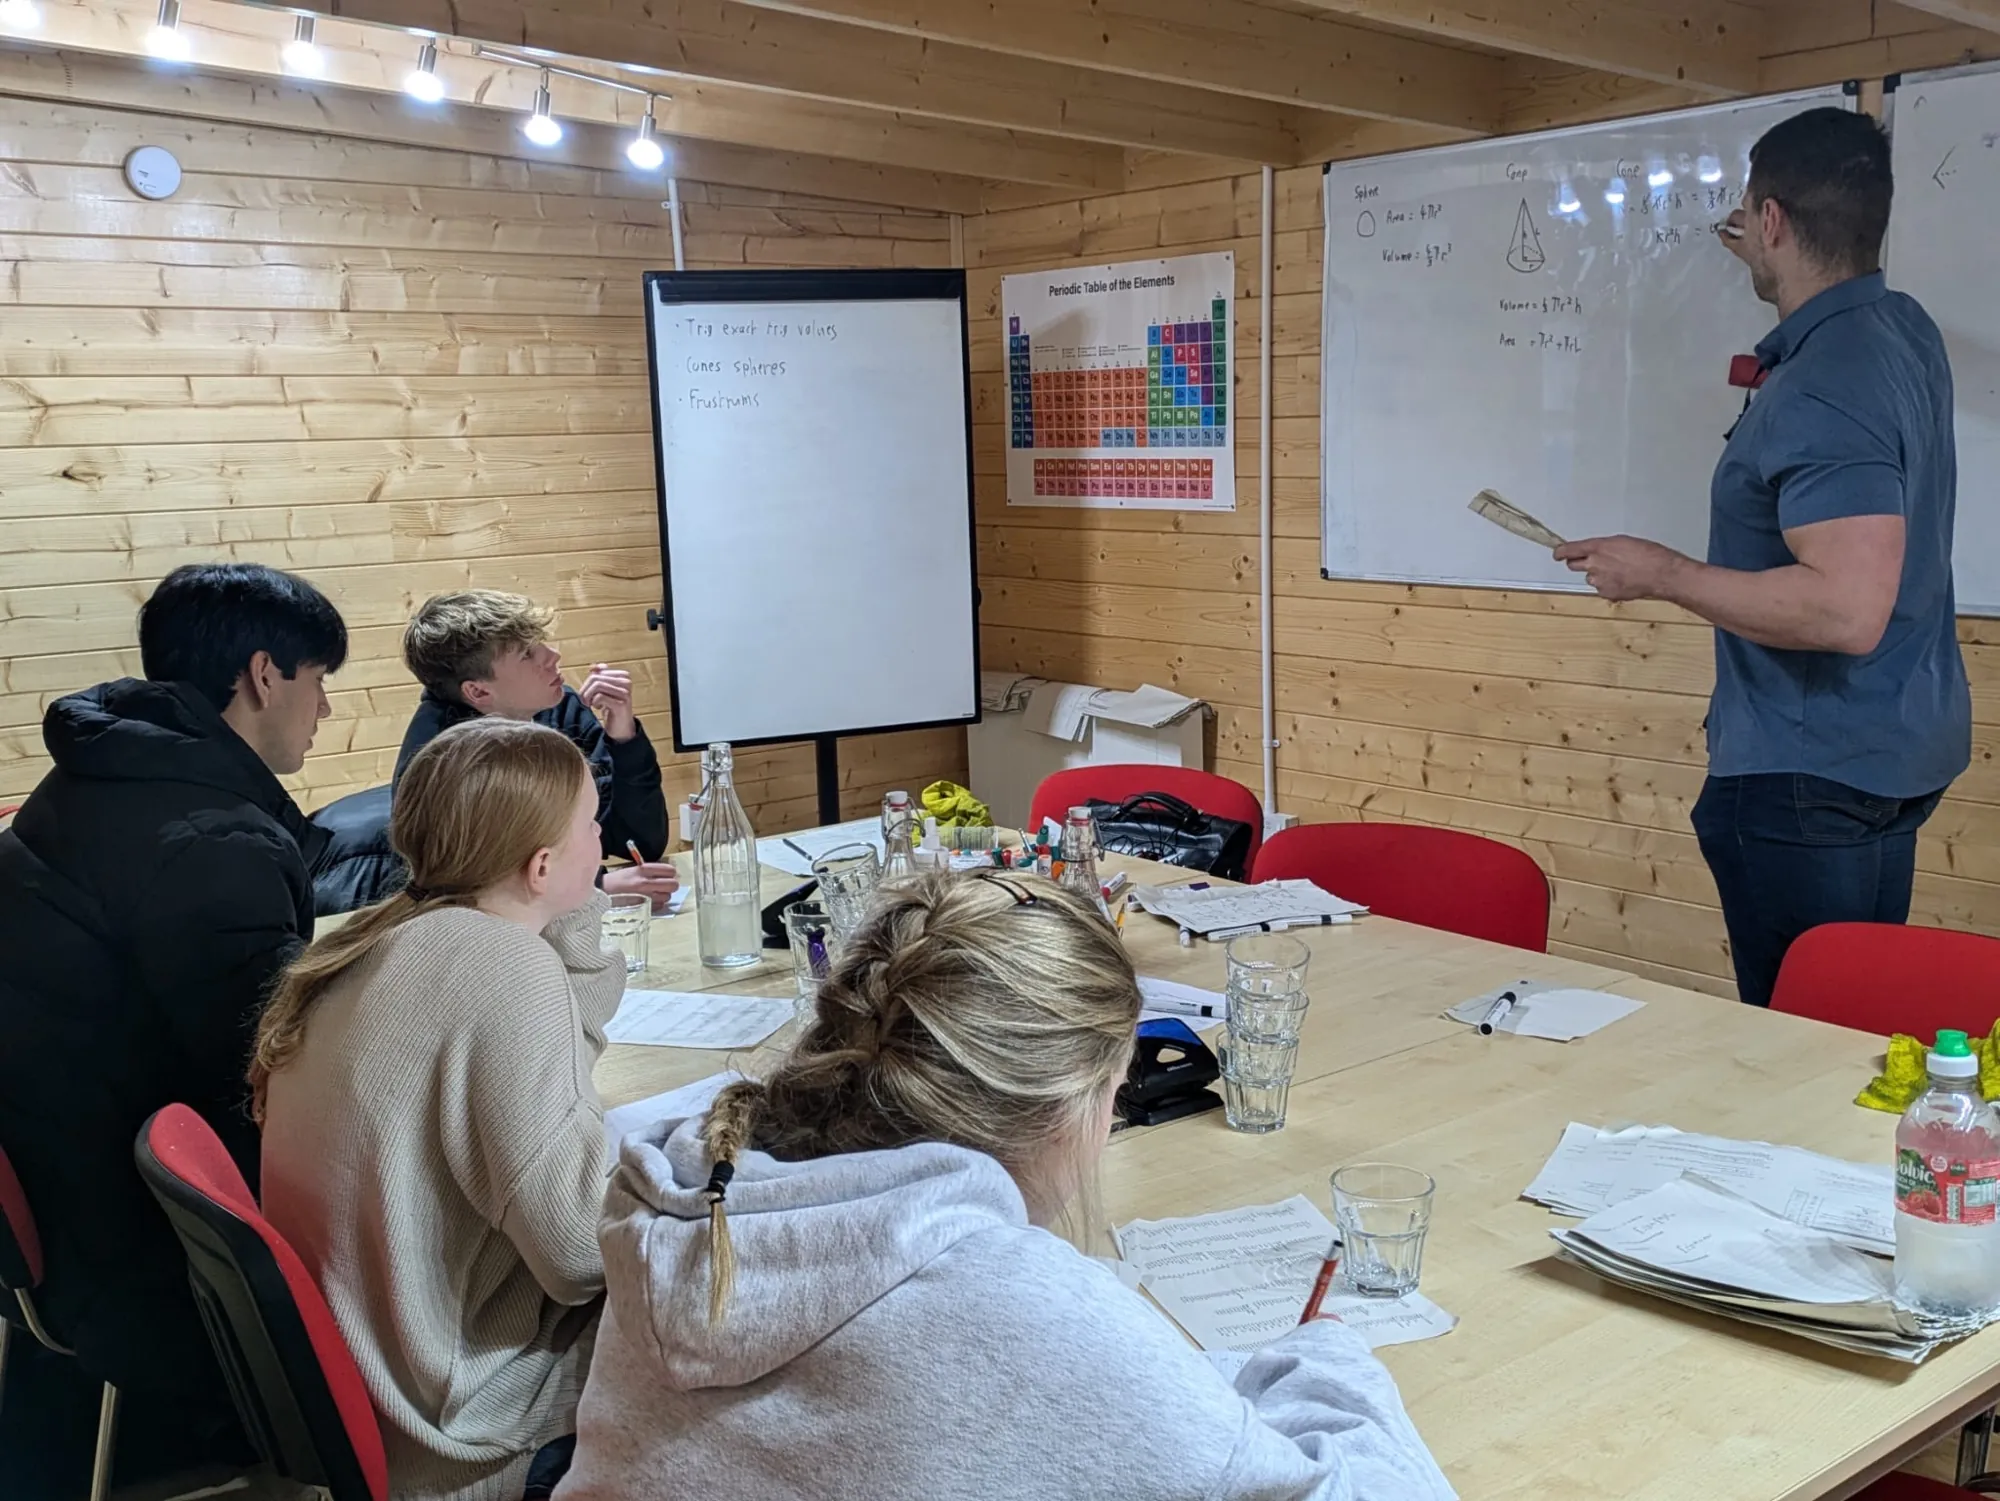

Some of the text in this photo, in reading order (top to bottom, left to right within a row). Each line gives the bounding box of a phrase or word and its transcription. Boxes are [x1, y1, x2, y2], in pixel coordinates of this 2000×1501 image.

[1386, 209, 1405, 224] Area
[1382, 248, 1413, 262] Volume
[1049, 275, 1175, 297] Periodic Table of the Elements
[1500, 298, 1529, 311] Volume
[684, 318, 838, 341] Trig exact trig values
[686, 355, 787, 378] Cones spheres
